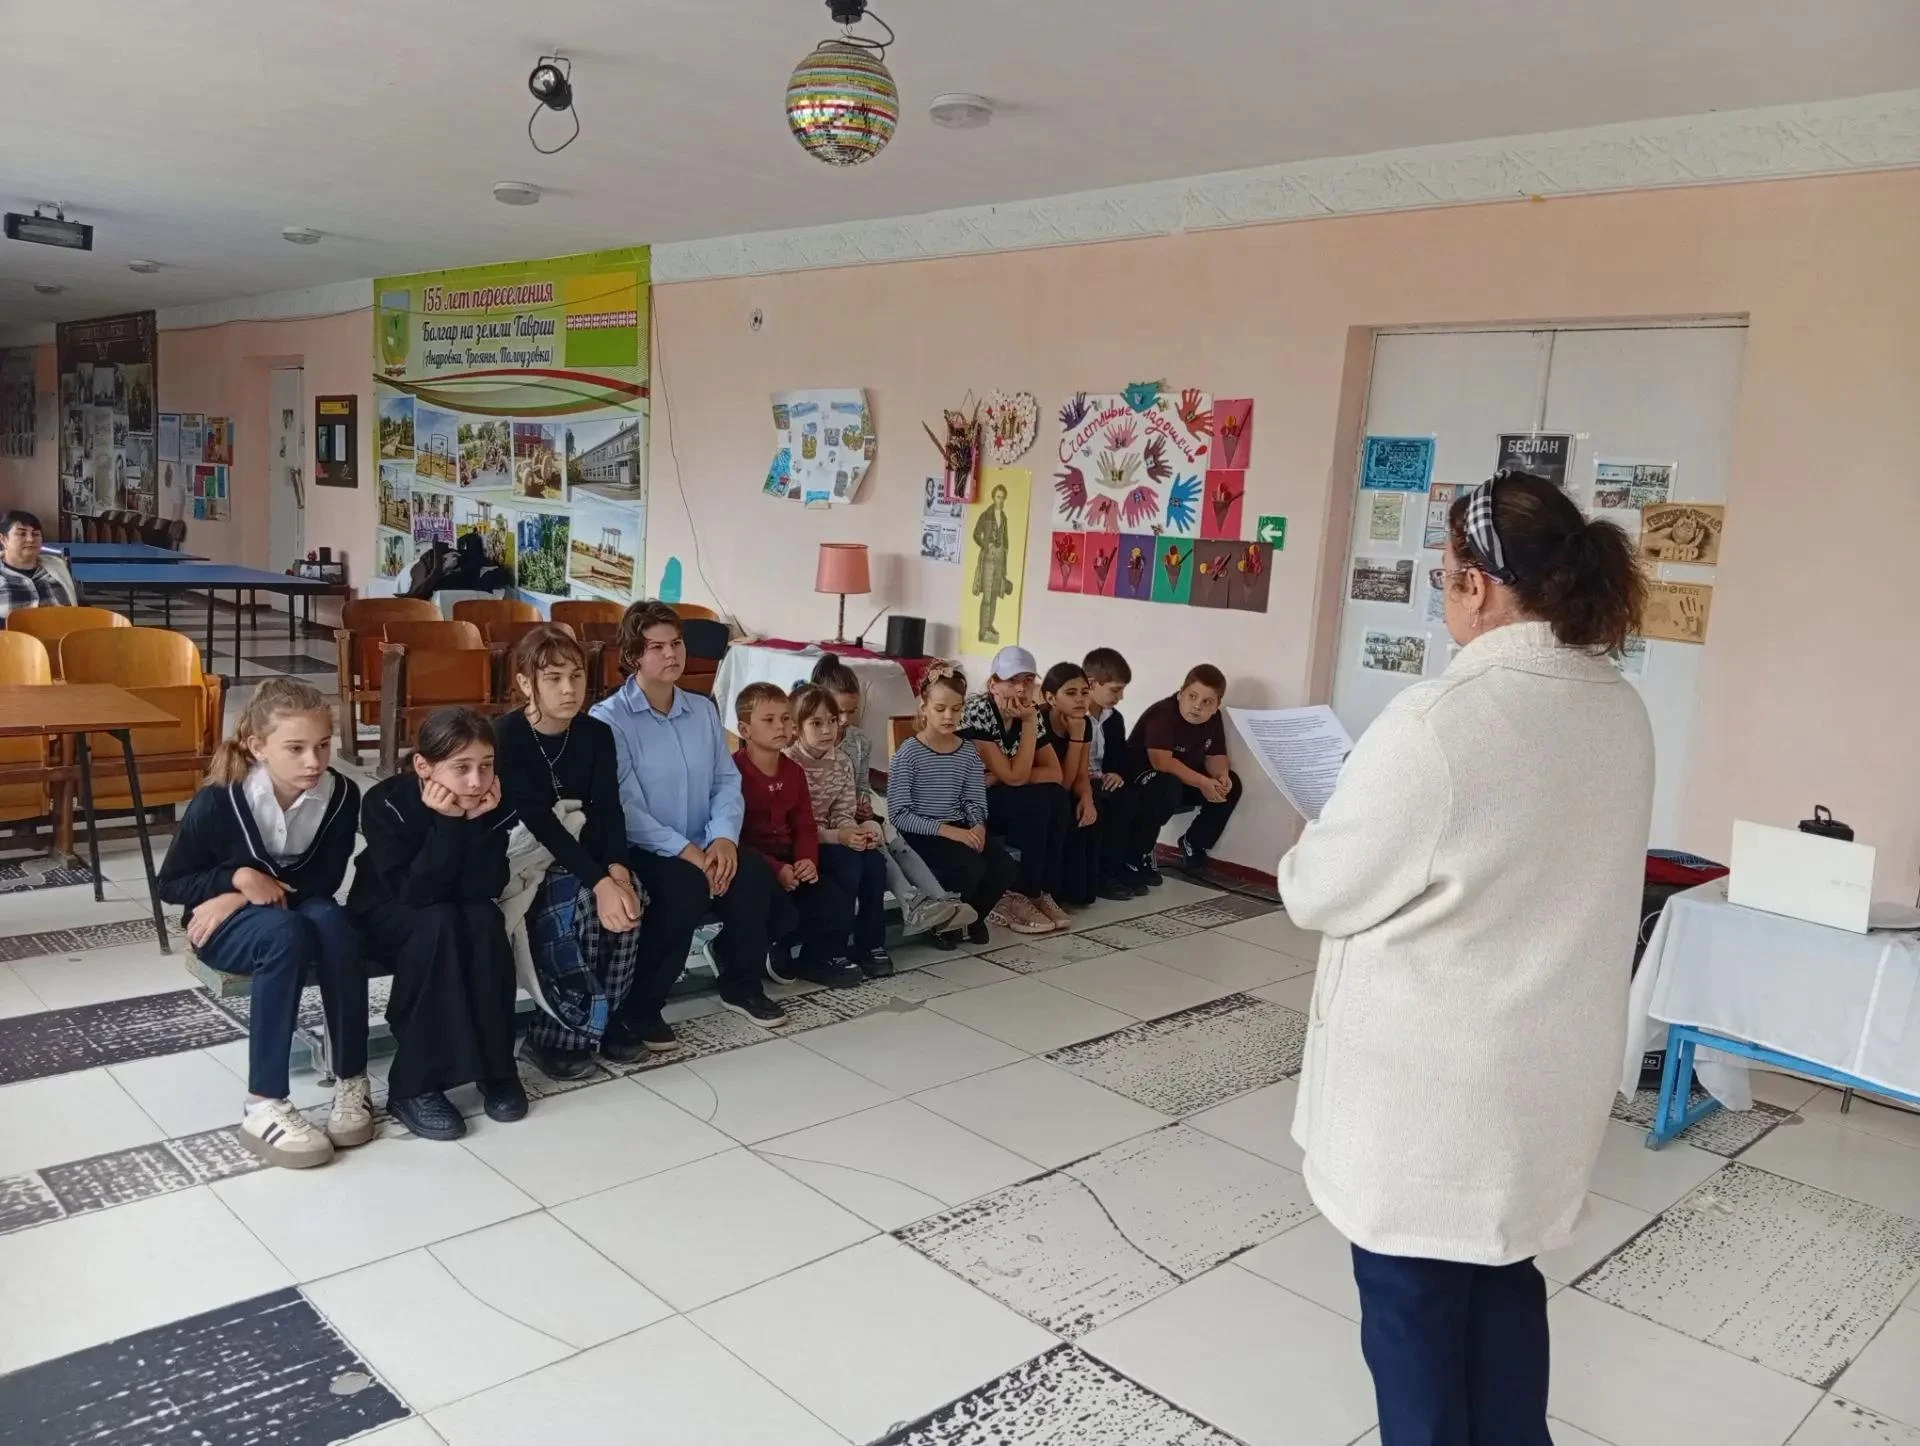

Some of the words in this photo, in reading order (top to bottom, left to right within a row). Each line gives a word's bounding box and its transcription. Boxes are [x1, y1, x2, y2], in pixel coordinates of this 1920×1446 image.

[423, 287, 442, 312] 155
[444, 290, 470, 310] лет
[472, 282, 553, 314] переселения
[423, 321, 458, 346] Болгар
[460, 325, 473, 339] на
[475, 321, 512, 345] земли
[514, 315, 555, 343] Таврии
[1507, 439, 1559, 454] БЕСЛАН
